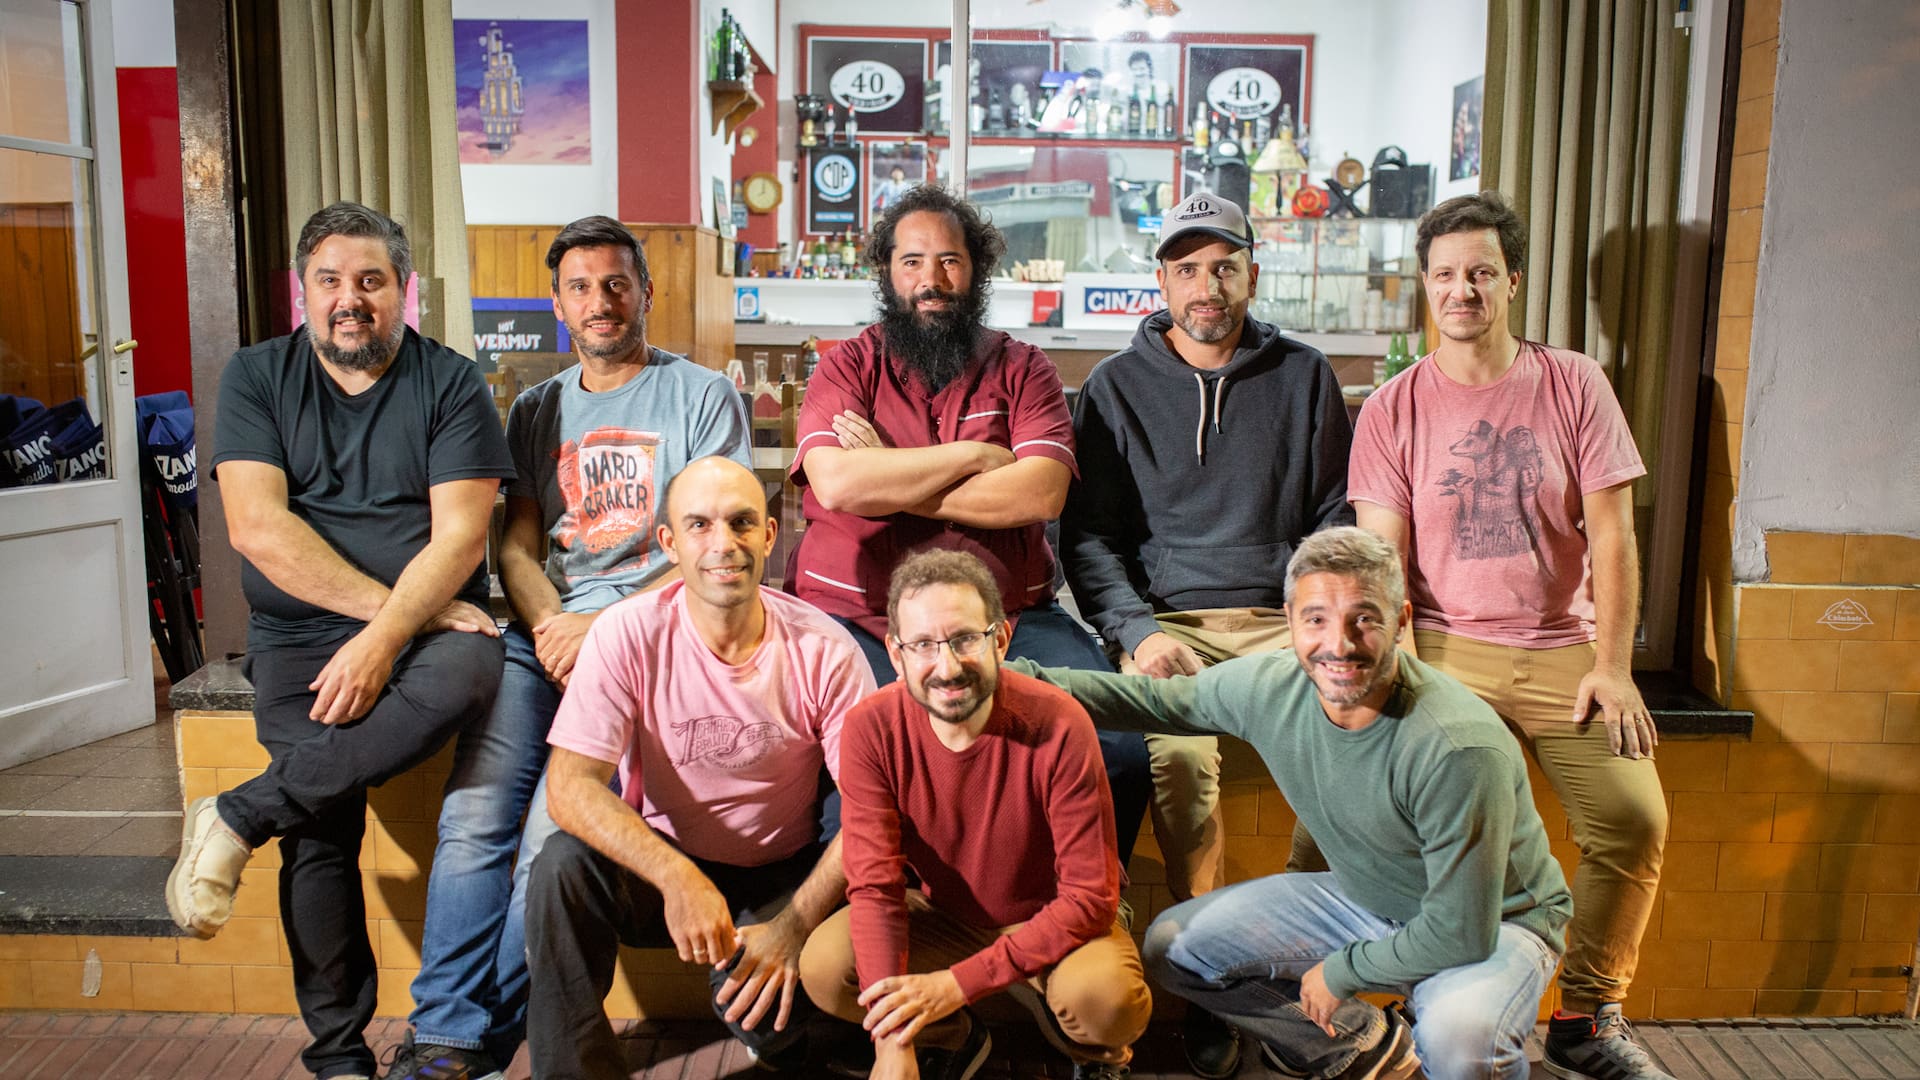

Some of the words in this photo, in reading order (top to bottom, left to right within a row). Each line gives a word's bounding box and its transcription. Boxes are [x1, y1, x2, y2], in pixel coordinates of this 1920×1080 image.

[850, 72, 884, 94] 40
[1227, 79, 1261, 101] 40
[1186, 201, 1209, 214] 40
[1087, 290, 1168, 314] CINZAN
[497, 319, 516, 333] HOY
[474, 333, 542, 351] VERMUT
[584, 450, 637, 490] HARD
[583, 483, 648, 521] BRAKER
